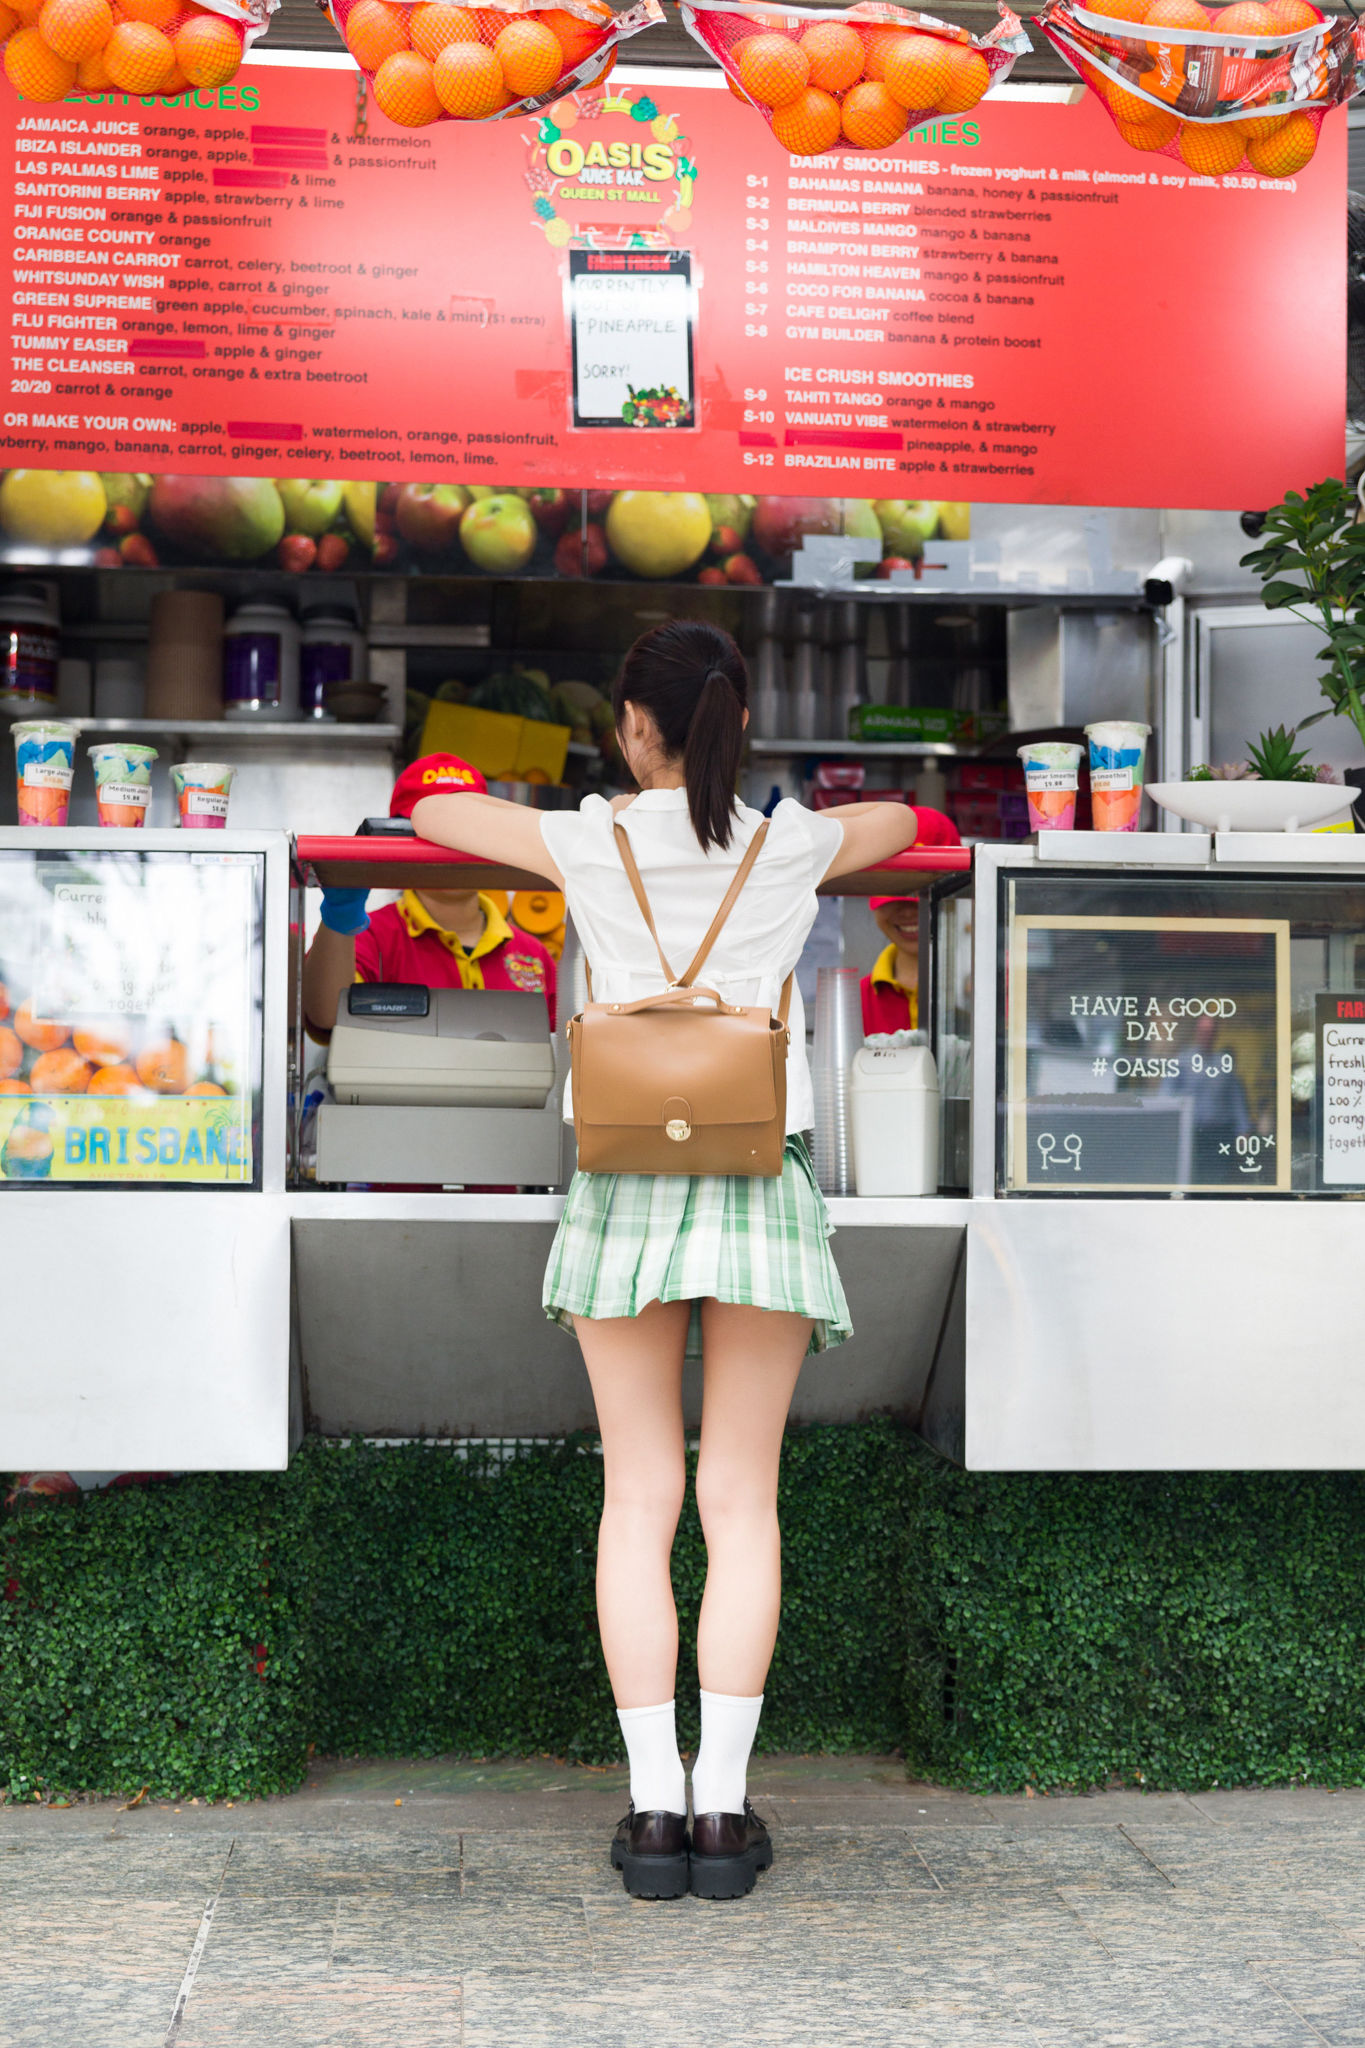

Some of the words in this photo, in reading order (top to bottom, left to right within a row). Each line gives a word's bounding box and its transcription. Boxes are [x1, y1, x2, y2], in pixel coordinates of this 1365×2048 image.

[16, 117, 88, 133] JAMAICA
[92, 120, 138, 135] JUICE
[346, 129, 431, 147] watermelon
[15, 139, 56, 153] IBIZA
[61, 141, 141, 157] ISLANDER
[348, 155, 437, 171] passionfruit
[547, 139, 675, 181] OASIS
[15, 160, 47, 174] LAS
[51, 162, 116, 177] PALMAS
[121, 165, 158, 179] LIME
[577, 168, 613, 185] JUICE
[616, 169, 645, 186] BAR
[790, 154, 839, 169] DAIRY
[843, 156, 939, 174] SMOOTHIES
[950, 163, 992, 177] frozen
[995, 166, 1045, 182] yoghurt
[1062, 169, 1089, 181] milk
[1092, 170, 1145, 185] (almond
[1162, 175, 1185, 188] soy
[1188, 175, 1219, 188] milk,
[1222, 176, 1257, 189] $0.50
[1259, 177, 1296, 192] extra)
[14, 182, 102, 198] SANTORINI
[105, 186, 161, 201] BERRY
[215, 193, 293, 208] strawberry
[560, 187, 605, 201] QUEEN
[607, 188, 625, 201] ST
[626, 190, 662, 204] MALL
[745, 174, 768, 187] S-1
[787, 176, 860, 192] BAHAMAS
[863, 181, 924, 195] BANANA
[982, 188, 1023, 200] honey
[1040, 190, 1119, 204] passionfruit
[14, 204, 42, 218] FIJI
[46, 205, 106, 220] FUSION
[110, 211, 163, 226] orange
[183, 213, 272, 229] passionfruit
[745, 196, 770, 208] S-2
[787, 198, 858, 212] BERMUDA
[862, 201, 910, 215] BERRY
[914, 206, 966, 217] blended
[971, 208, 1051, 221] strawberries
[14, 225, 82, 241] ORANGE
[88, 229, 154, 244] COUNTY
[159, 235, 210, 249] orange
[745, 217, 769, 230] S-3
[787, 219, 860, 234] MALDIVES
[863, 222, 917, 237] MANGO
[921, 229, 964, 240] mango
[12, 247, 108, 264] CARIBBEAN
[112, 251, 181, 267] CARROT
[290, 261, 352, 274] beetroot
[745, 238, 768, 251] S-4
[786, 240, 868, 256] BRAMPTON
[871, 244, 919, 258] BERRY
[923, 249, 993, 263] strawberry
[12, 269, 119, 286] WHITSUNDAY
[123, 274, 164, 288] WISH
[218, 280, 262, 292] carrot
[744, 259, 769, 273] S-5
[786, 262, 860, 276] HAMILTON
[862, 265, 920, 279] HEAVEN
[986, 272, 1065, 286] passionfruit
[579, 278, 669, 293] CURRENTLY
[744, 281, 768, 294] S-6
[785, 283, 829, 296] COCO
[831, 285, 862, 298] FOR
[865, 287, 926, 301] BANANA
[12, 291, 69, 306] GREEN
[73, 294, 151, 310] SUPREME
[744, 302, 768, 315] S-7
[786, 304, 824, 318] CAFE
[828, 306, 889, 320] DELIGHT
[894, 311, 933, 321] coffee
[12, 313, 43, 327] FLU
[48, 314, 117, 330] FIGHTER
[289, 328, 335, 341] ginger
[588, 317, 677, 336] PINEAPPLE
[743, 324, 768, 337] S-8
[785, 325, 819, 339] GYM
[821, 327, 884, 342] BUILDER
[953, 335, 999, 347] protein
[10, 335, 70, 350] TUMMY
[73, 337, 128, 352] EASER
[214, 345, 255, 359] apple
[274, 349, 323, 362] ginger
[11, 357, 43, 371] THE
[47, 358, 135, 374] CLEANSER
[192, 367, 244, 381] orange
[583, 363, 630, 380] SORRY!
[784, 367, 812, 381] ICE
[815, 368, 874, 384] CRUSH
[877, 371, 974, 388] SMOOTHIES
[10, 379, 51, 393] 20/20
[55, 382, 101, 394] carrot
[120, 387, 173, 400] orange
[743, 388, 767, 401] S-9
[785, 390, 830, 403] TAHITI
[833, 392, 883, 406] TANGO
[886, 397, 932, 410] orange
[4, 412, 27, 426] OR
[32, 414, 78, 428] MAKE
[84, 415, 128, 430] YOUR
[132, 417, 176, 432] OWN:
[743, 409, 775, 423] S-10
[785, 411, 852, 426] VANUATU
[855, 414, 888, 427] VIBE
[892, 418, 967, 430] watermelon
[986, 421, 1056, 435] strawberry
[742, 452, 774, 465] S-12
[784, 454, 860, 469] BRAZILIAN
[863, 457, 895, 470] BITE
[953, 463, 1034, 475] strawberries
[421, 766, 476, 785] OASIS
[109, 785, 136, 793] Medium
[371, 1004, 407, 1012] SHARP
[1070, 997, 1138, 1016] HAVE
[1145, 997, 1162, 1016] A
[1169, 997, 1237, 1018] GOOD
[1126, 1021, 1178, 1041] DAY
[1113, 1058, 1180, 1077] OASIS
[64, 1126, 248, 1166] BRISBANE
